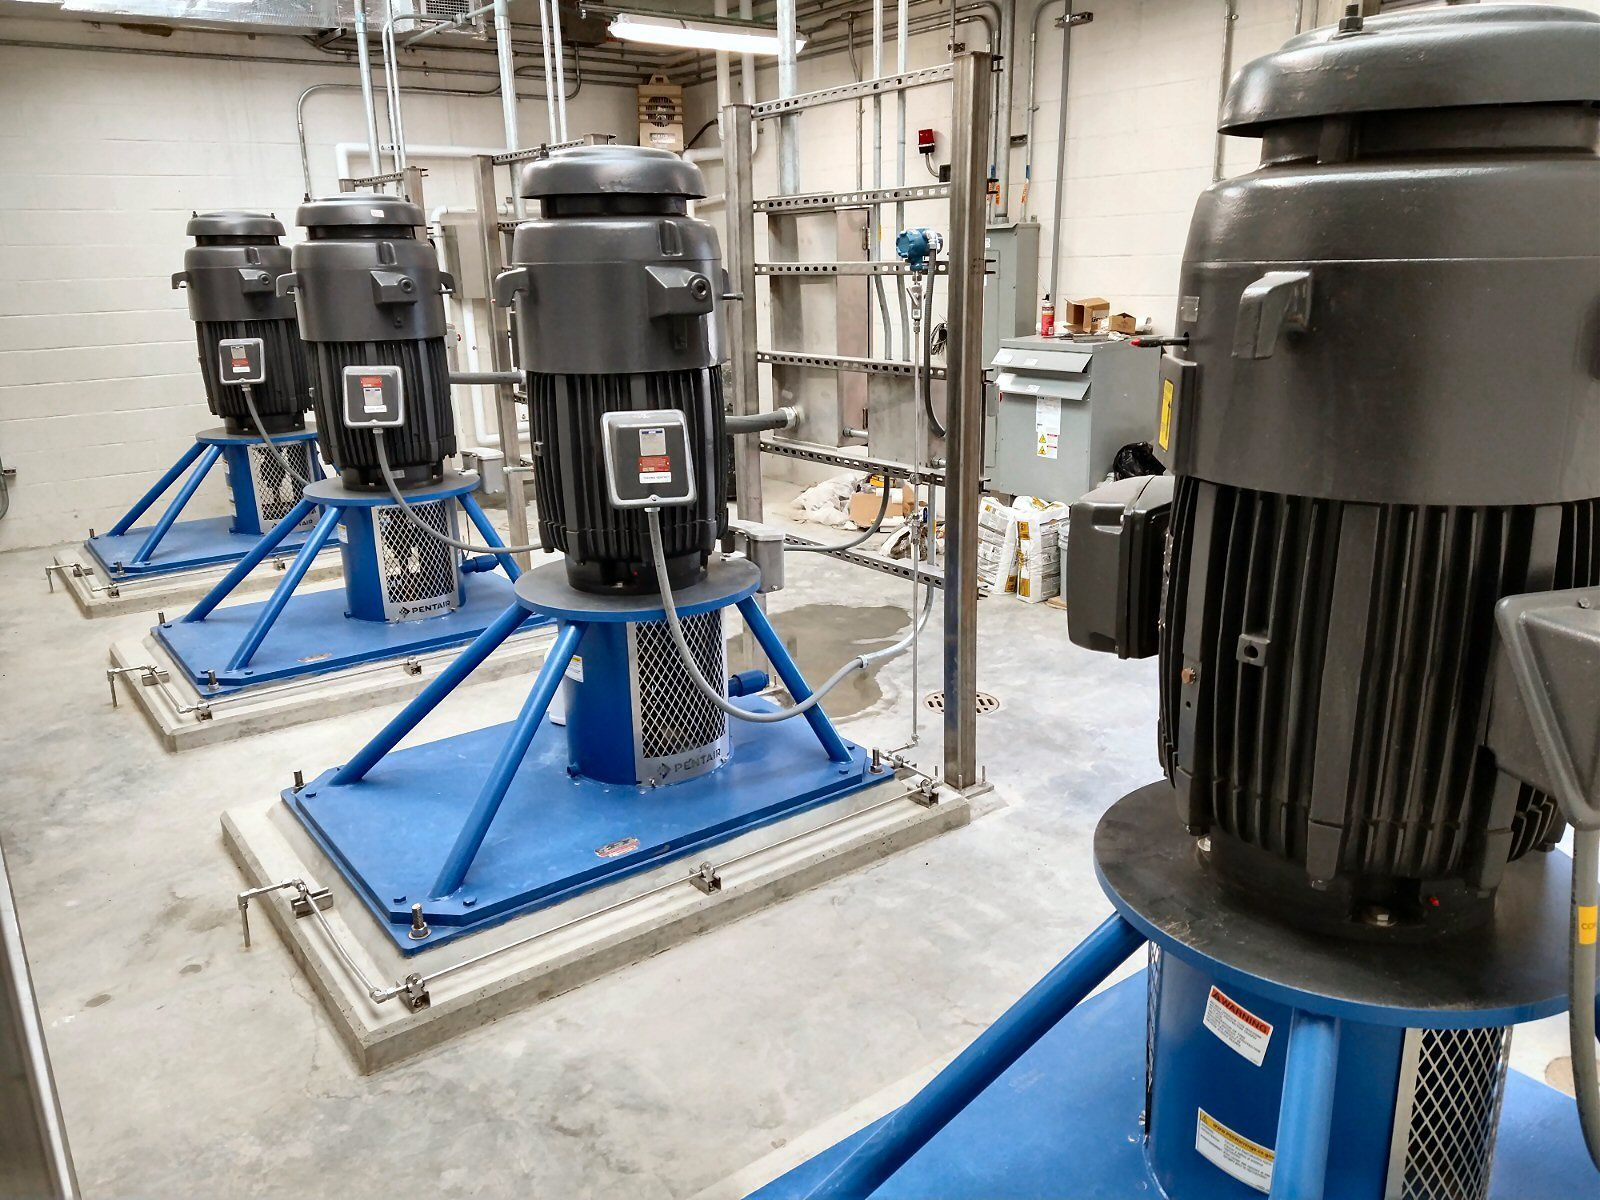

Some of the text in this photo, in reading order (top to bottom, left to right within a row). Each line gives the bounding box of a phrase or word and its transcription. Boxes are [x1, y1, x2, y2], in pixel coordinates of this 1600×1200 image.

[411, 600, 451, 614] PENTAIR
[674, 748, 721, 772] PENTAIR
[1220, 998, 1268, 1035] WARNING
